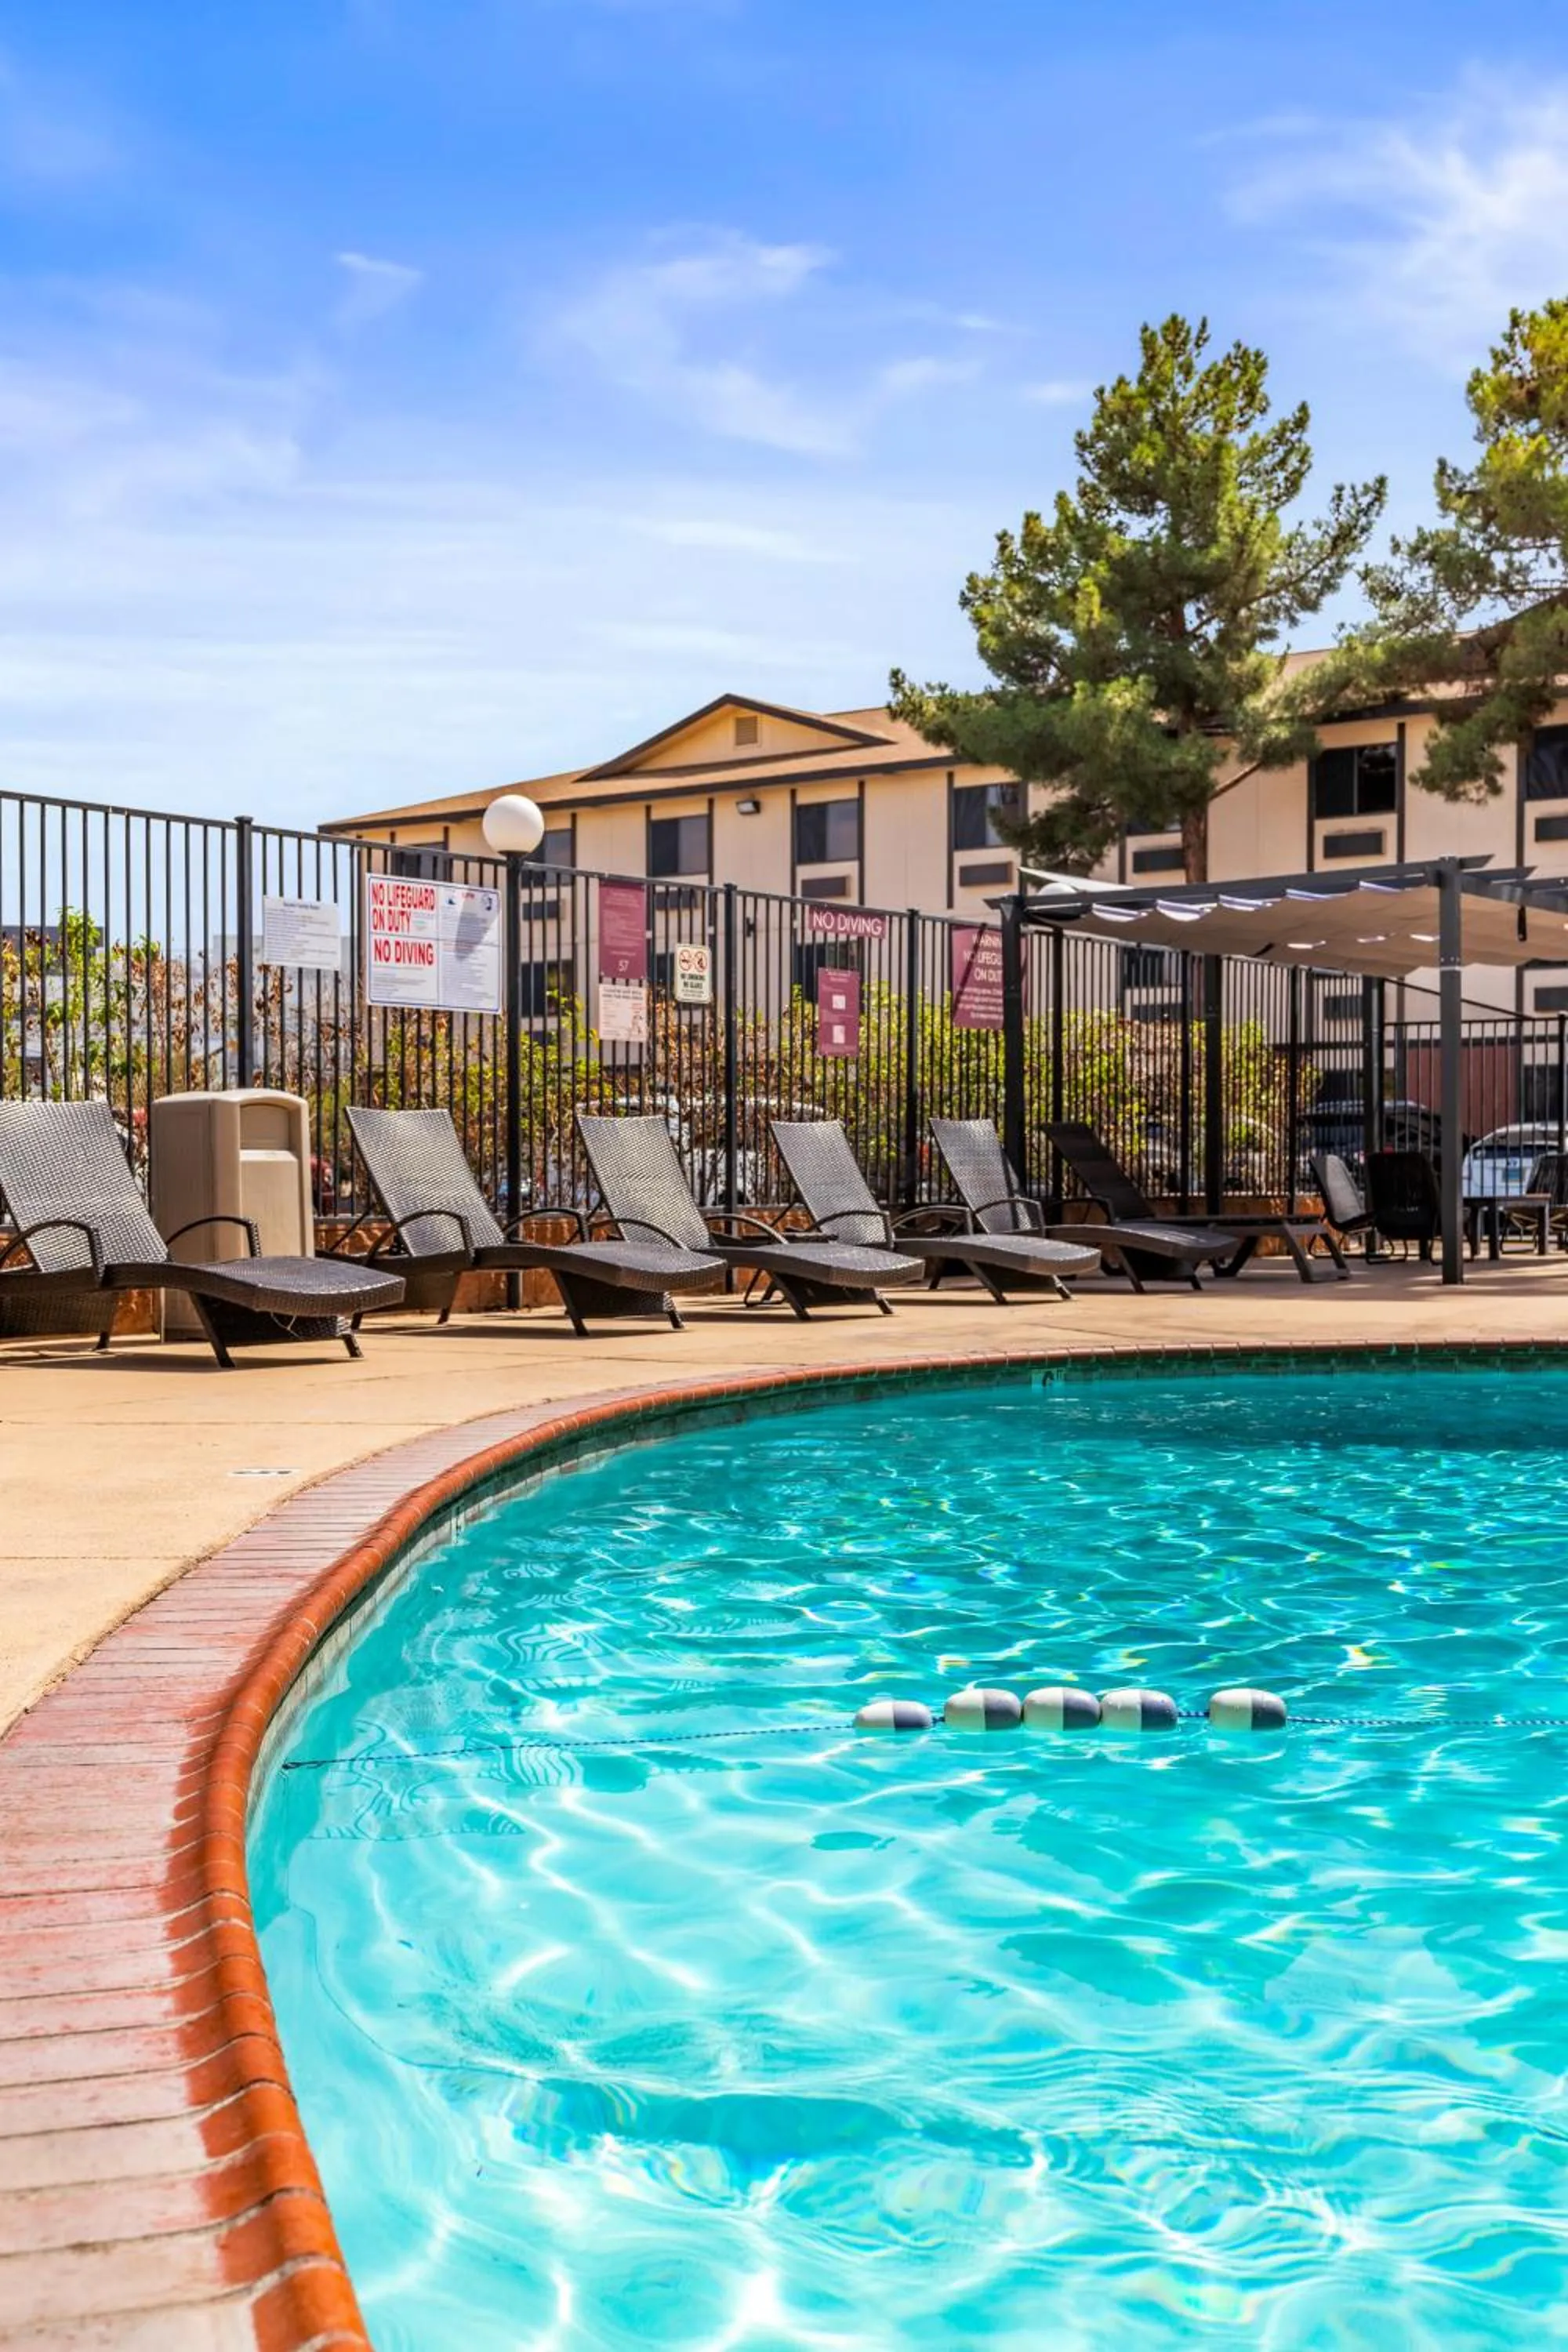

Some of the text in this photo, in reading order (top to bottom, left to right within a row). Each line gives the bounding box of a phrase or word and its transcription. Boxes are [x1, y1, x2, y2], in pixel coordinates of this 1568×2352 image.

[372, 883, 435, 910] NO LIFEGUARD
[372, 908, 385, 931] ON
[387, 909, 412, 934] DUTY
[813, 910, 883, 935] NO DIVING
[374, 938, 434, 966] NO DIVING
[974, 967, 986, 982] ON
